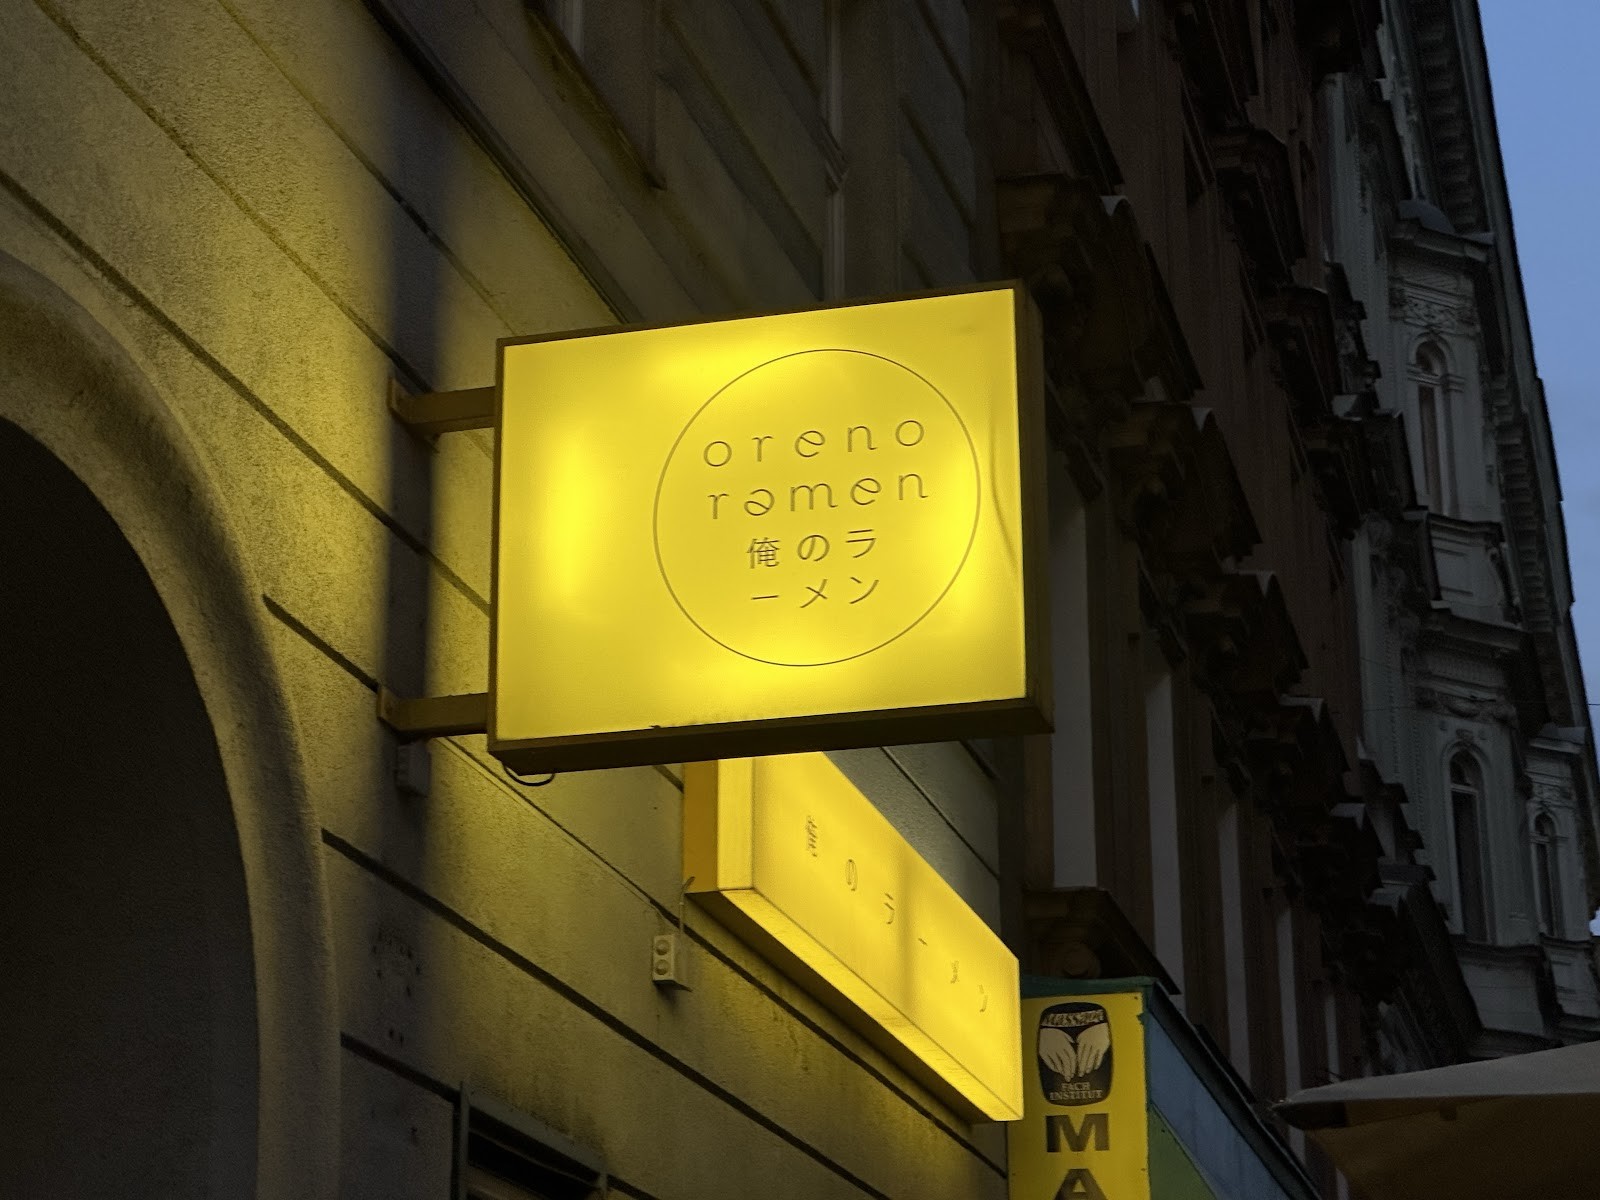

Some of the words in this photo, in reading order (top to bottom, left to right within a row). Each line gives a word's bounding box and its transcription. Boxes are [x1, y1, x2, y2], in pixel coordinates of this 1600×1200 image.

[702, 419, 926, 468] oreno
[706, 472, 930, 521] ramen
[746, 528, 878, 570] 俺のラ
